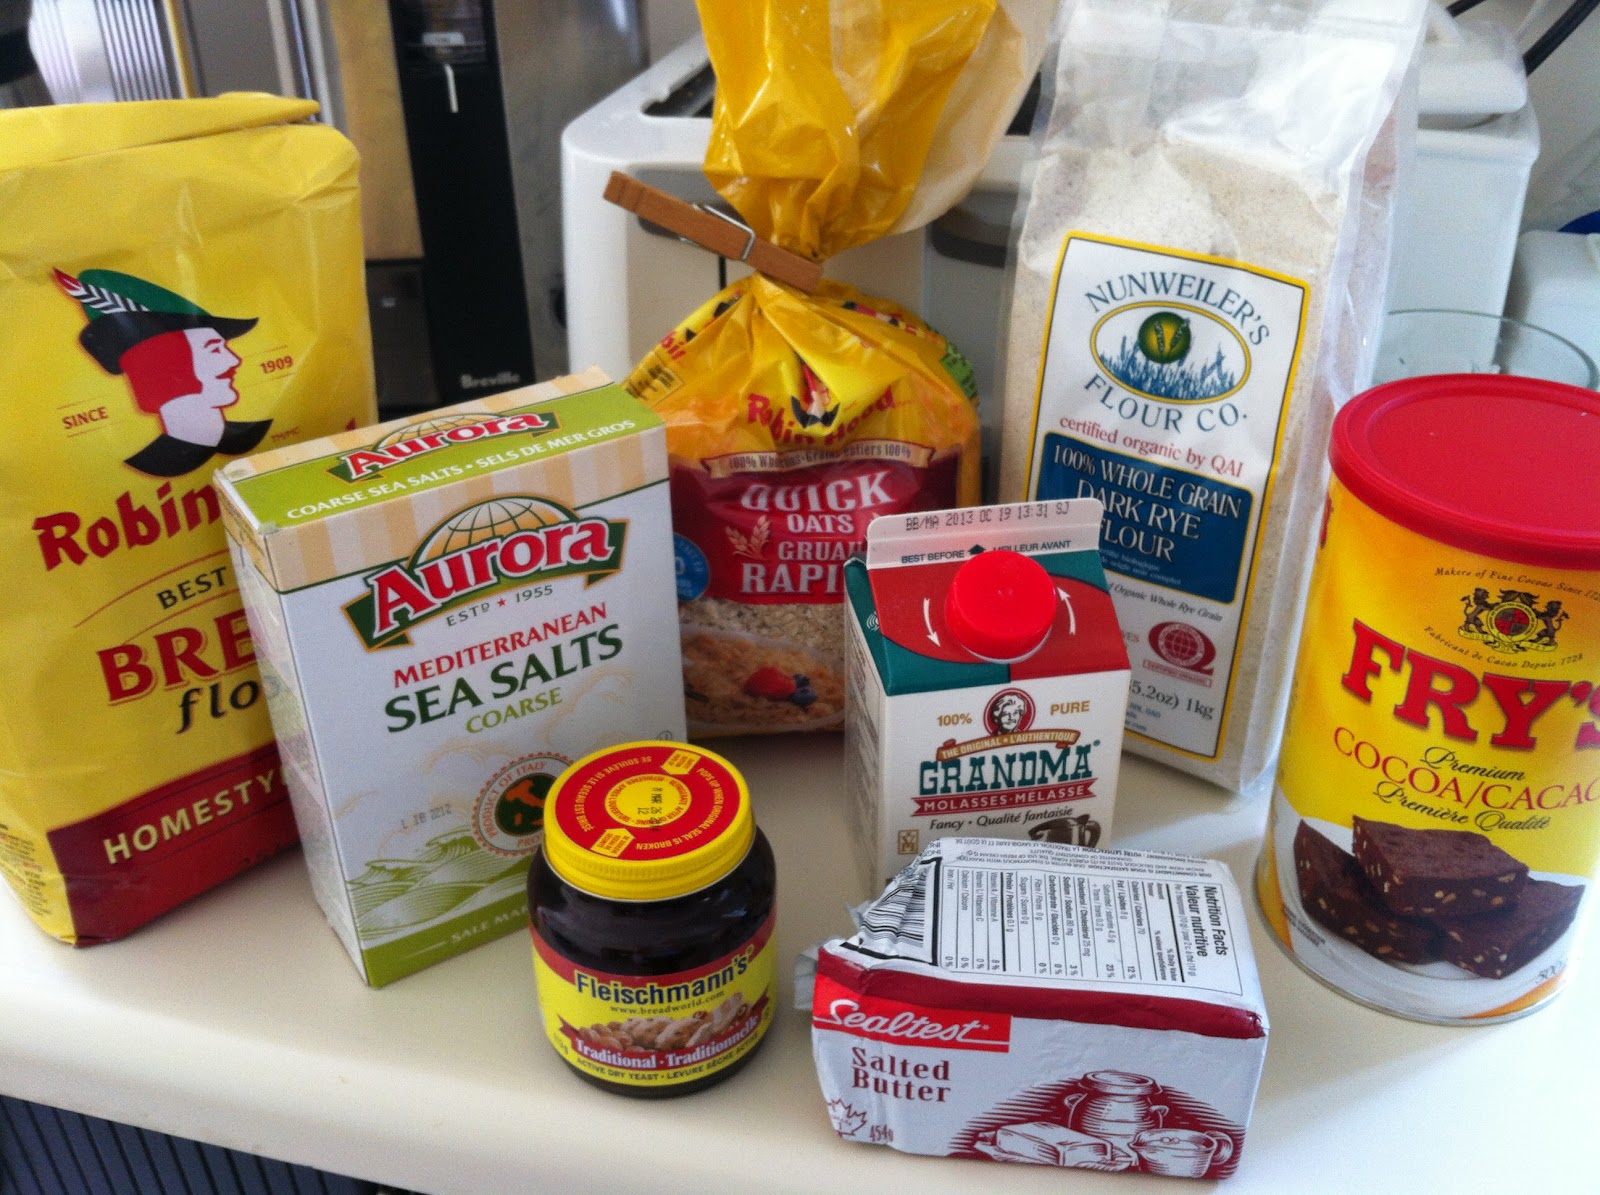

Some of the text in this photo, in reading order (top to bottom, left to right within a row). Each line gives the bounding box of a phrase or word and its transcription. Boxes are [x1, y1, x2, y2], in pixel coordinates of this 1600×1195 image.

[1085, 271, 1270, 346] NUNWEILER'S
[260, 356, 294, 375] 1909
[62, 406, 109, 430] SINCE
[1084, 373, 1182, 433] FLOUR
[341, 412, 550, 479] Aurora
[1060, 415, 1245, 478] certified organic by QAI
[286, 419, 637, 519] COARSE SEA SALTS SELS DE MER GROS
[1053, 444, 1242, 519] 100% WHOLE GRAIN
[32, 481, 222, 571] Robin
[786, 513, 854, 534] OATS
[905, 515, 940, 531] BB/MA
[945, 510, 974, 527] 2013
[979, 508, 993, 523] OC
[999, 507, 1011, 522] 19
[1055, 501, 1070, 515] SJ
[1077, 479, 1201, 539] DARK RYE
[901, 550, 965, 564] BEST BEFORE
[1040, 540, 1072, 550] AVANT
[157, 566, 228, 610] BEST
[373, 518, 616, 638] Aurora
[740, 563, 840, 593] RAPI
[1475, 568, 1488, 579] of
[516, 584, 553, 603] 1955
[1114, 584, 1223, 622] Organic Whole Rye Grain
[97, 608, 257, 706] BRE
[393, 602, 607, 688] MEDITERRANEAN
[384, 624, 624, 733] SEA SALTS
[176, 680, 262, 735] flo
[466, 687, 563, 733] COARSE
[937, 700, 1092, 727] 100% PURE
[941, 731, 1077, 759] THE ORIGINAL L'AUTHENTIQUE
[1419, 746, 1526, 781] Premium
[920, 743, 1093, 795] GRANDMA
[103, 764, 286, 865] HOMESTY
[713, 787, 724, 805] WHEN
[924, 792, 1007, 812] MOLASSES
[1373, 780, 1551, 832] Première Qualité
[681, 828, 703, 841] SEAL
[929, 806, 1074, 832] Fancy Qualité fantaisie
[636, 840, 672, 851] BROKEN
[672, 837, 683, 845] IS
[1185, 885, 1208, 957] Valeur nutritive
[1204, 886, 1228, 955] Nutrition Facts
[575, 953, 749, 1006] Fleischmann's
[609, 990, 725, 1015] www.breadworld.com
[826, 998, 980, 1043] Sealtest
[576, 1037, 656, 1069] Traditional
[851, 1045, 950, 1083] Salted
[608, 1067, 625, 1078] DRY
[628, 1070, 659, 1081] YEAST
[666, 1065, 703, 1080] LEVURE
[851, 1066, 951, 1103] Butter
